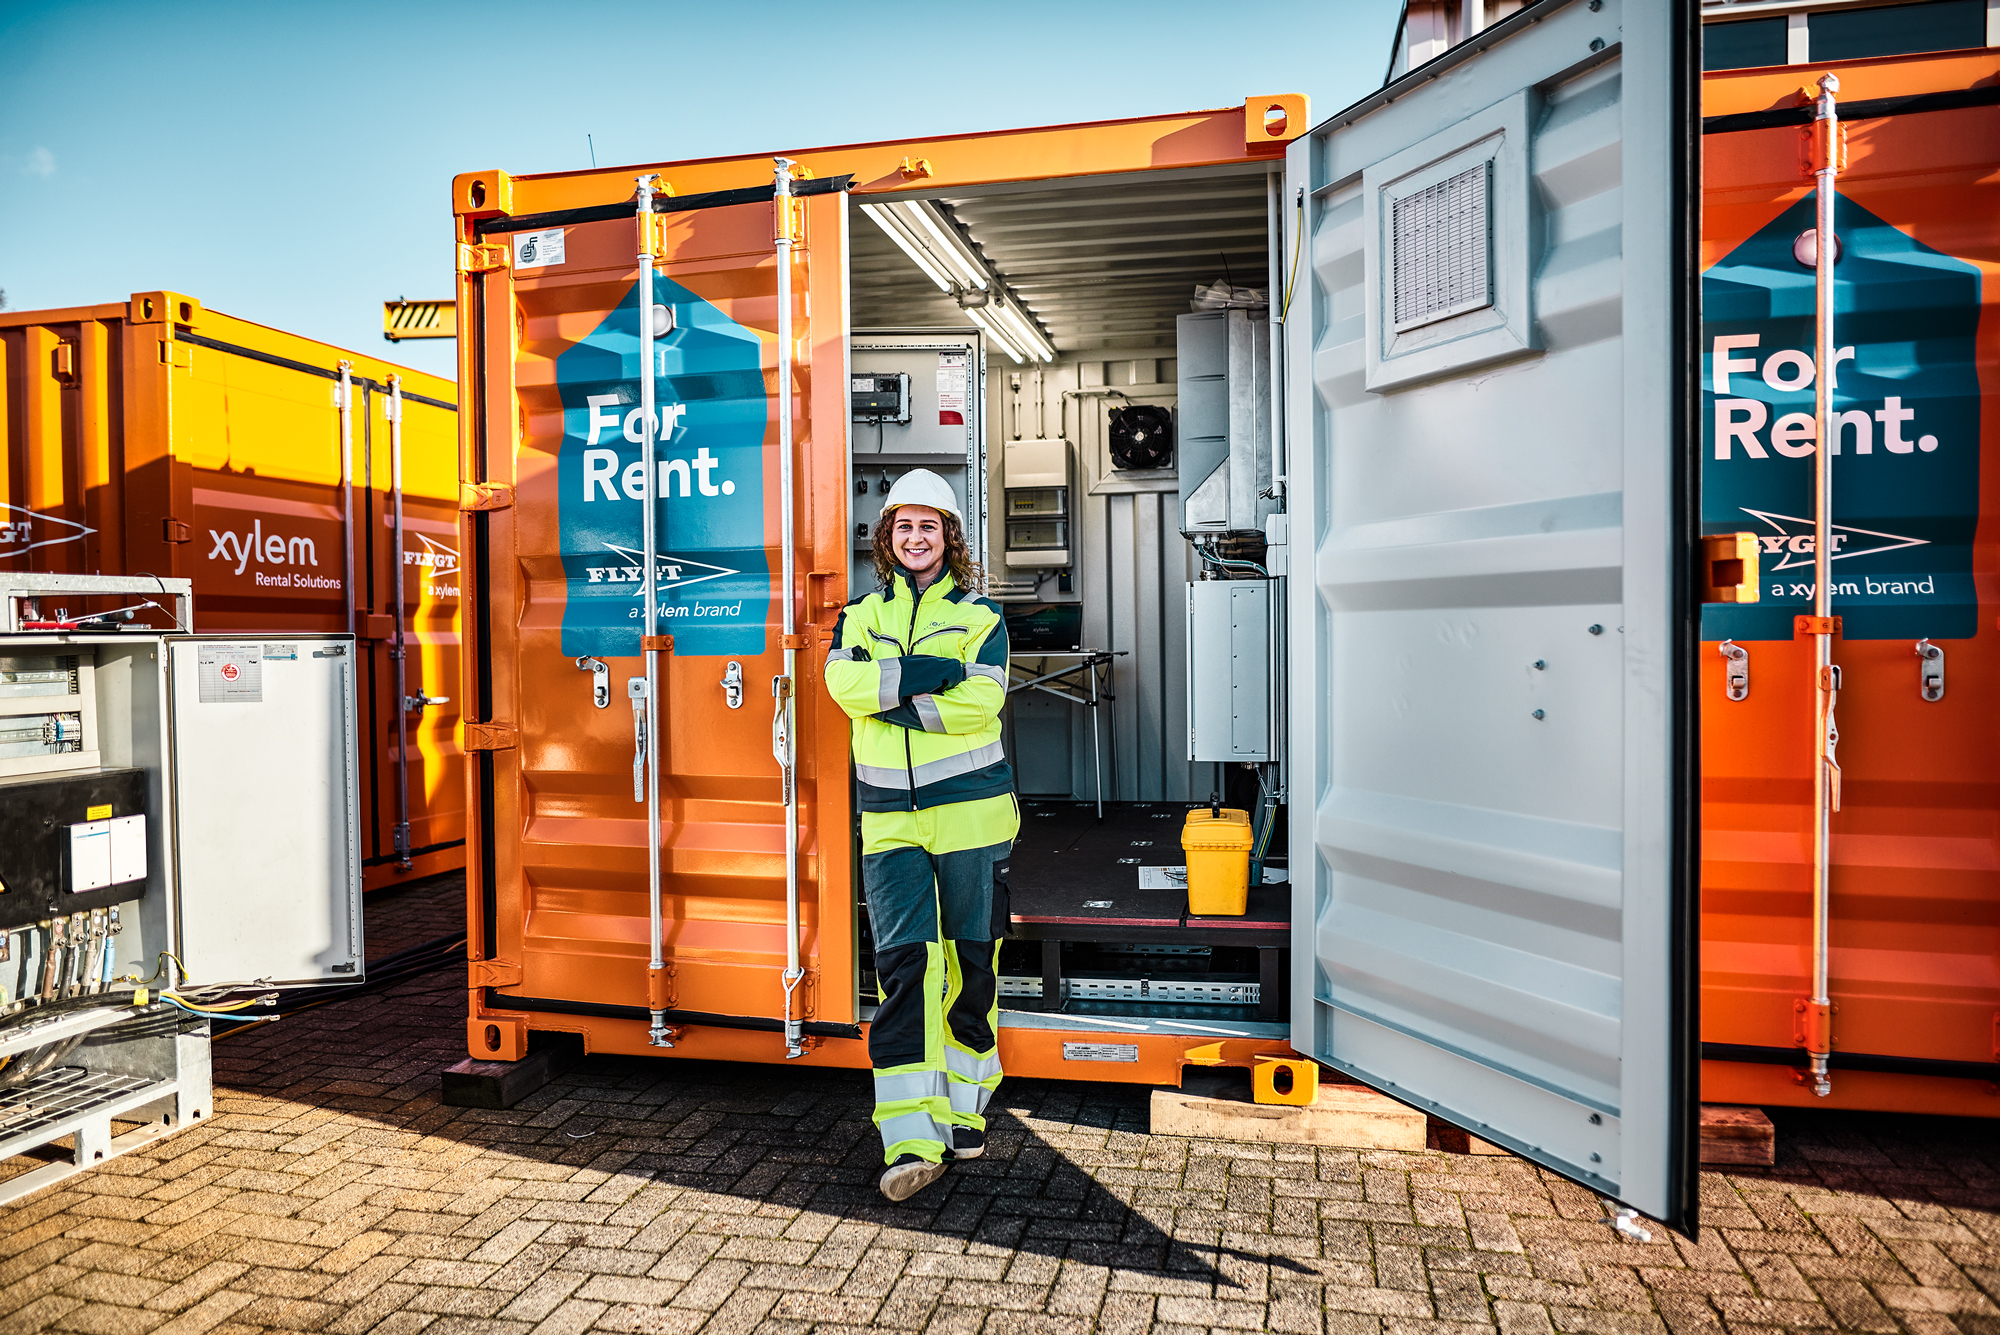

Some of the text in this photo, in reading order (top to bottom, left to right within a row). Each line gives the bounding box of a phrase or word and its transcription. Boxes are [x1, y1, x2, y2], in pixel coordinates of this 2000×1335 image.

[1712, 333, 1855, 394] For
[586, 393, 687, 446] For
[1714, 396, 1939, 460] Rent.
[583, 447, 736, 502] Rent.
[208, 519, 318, 575] xylem
[1758, 534, 1848, 554] YGT
[403, 551, 456, 568] FLYGT
[255, 572, 342, 589] Rental Solutions
[428, 582, 461, 600] a xylem
[1771, 575, 1935, 600] a xyem brand
[628, 607, 639, 618] a
[693, 600, 742, 617] brand
